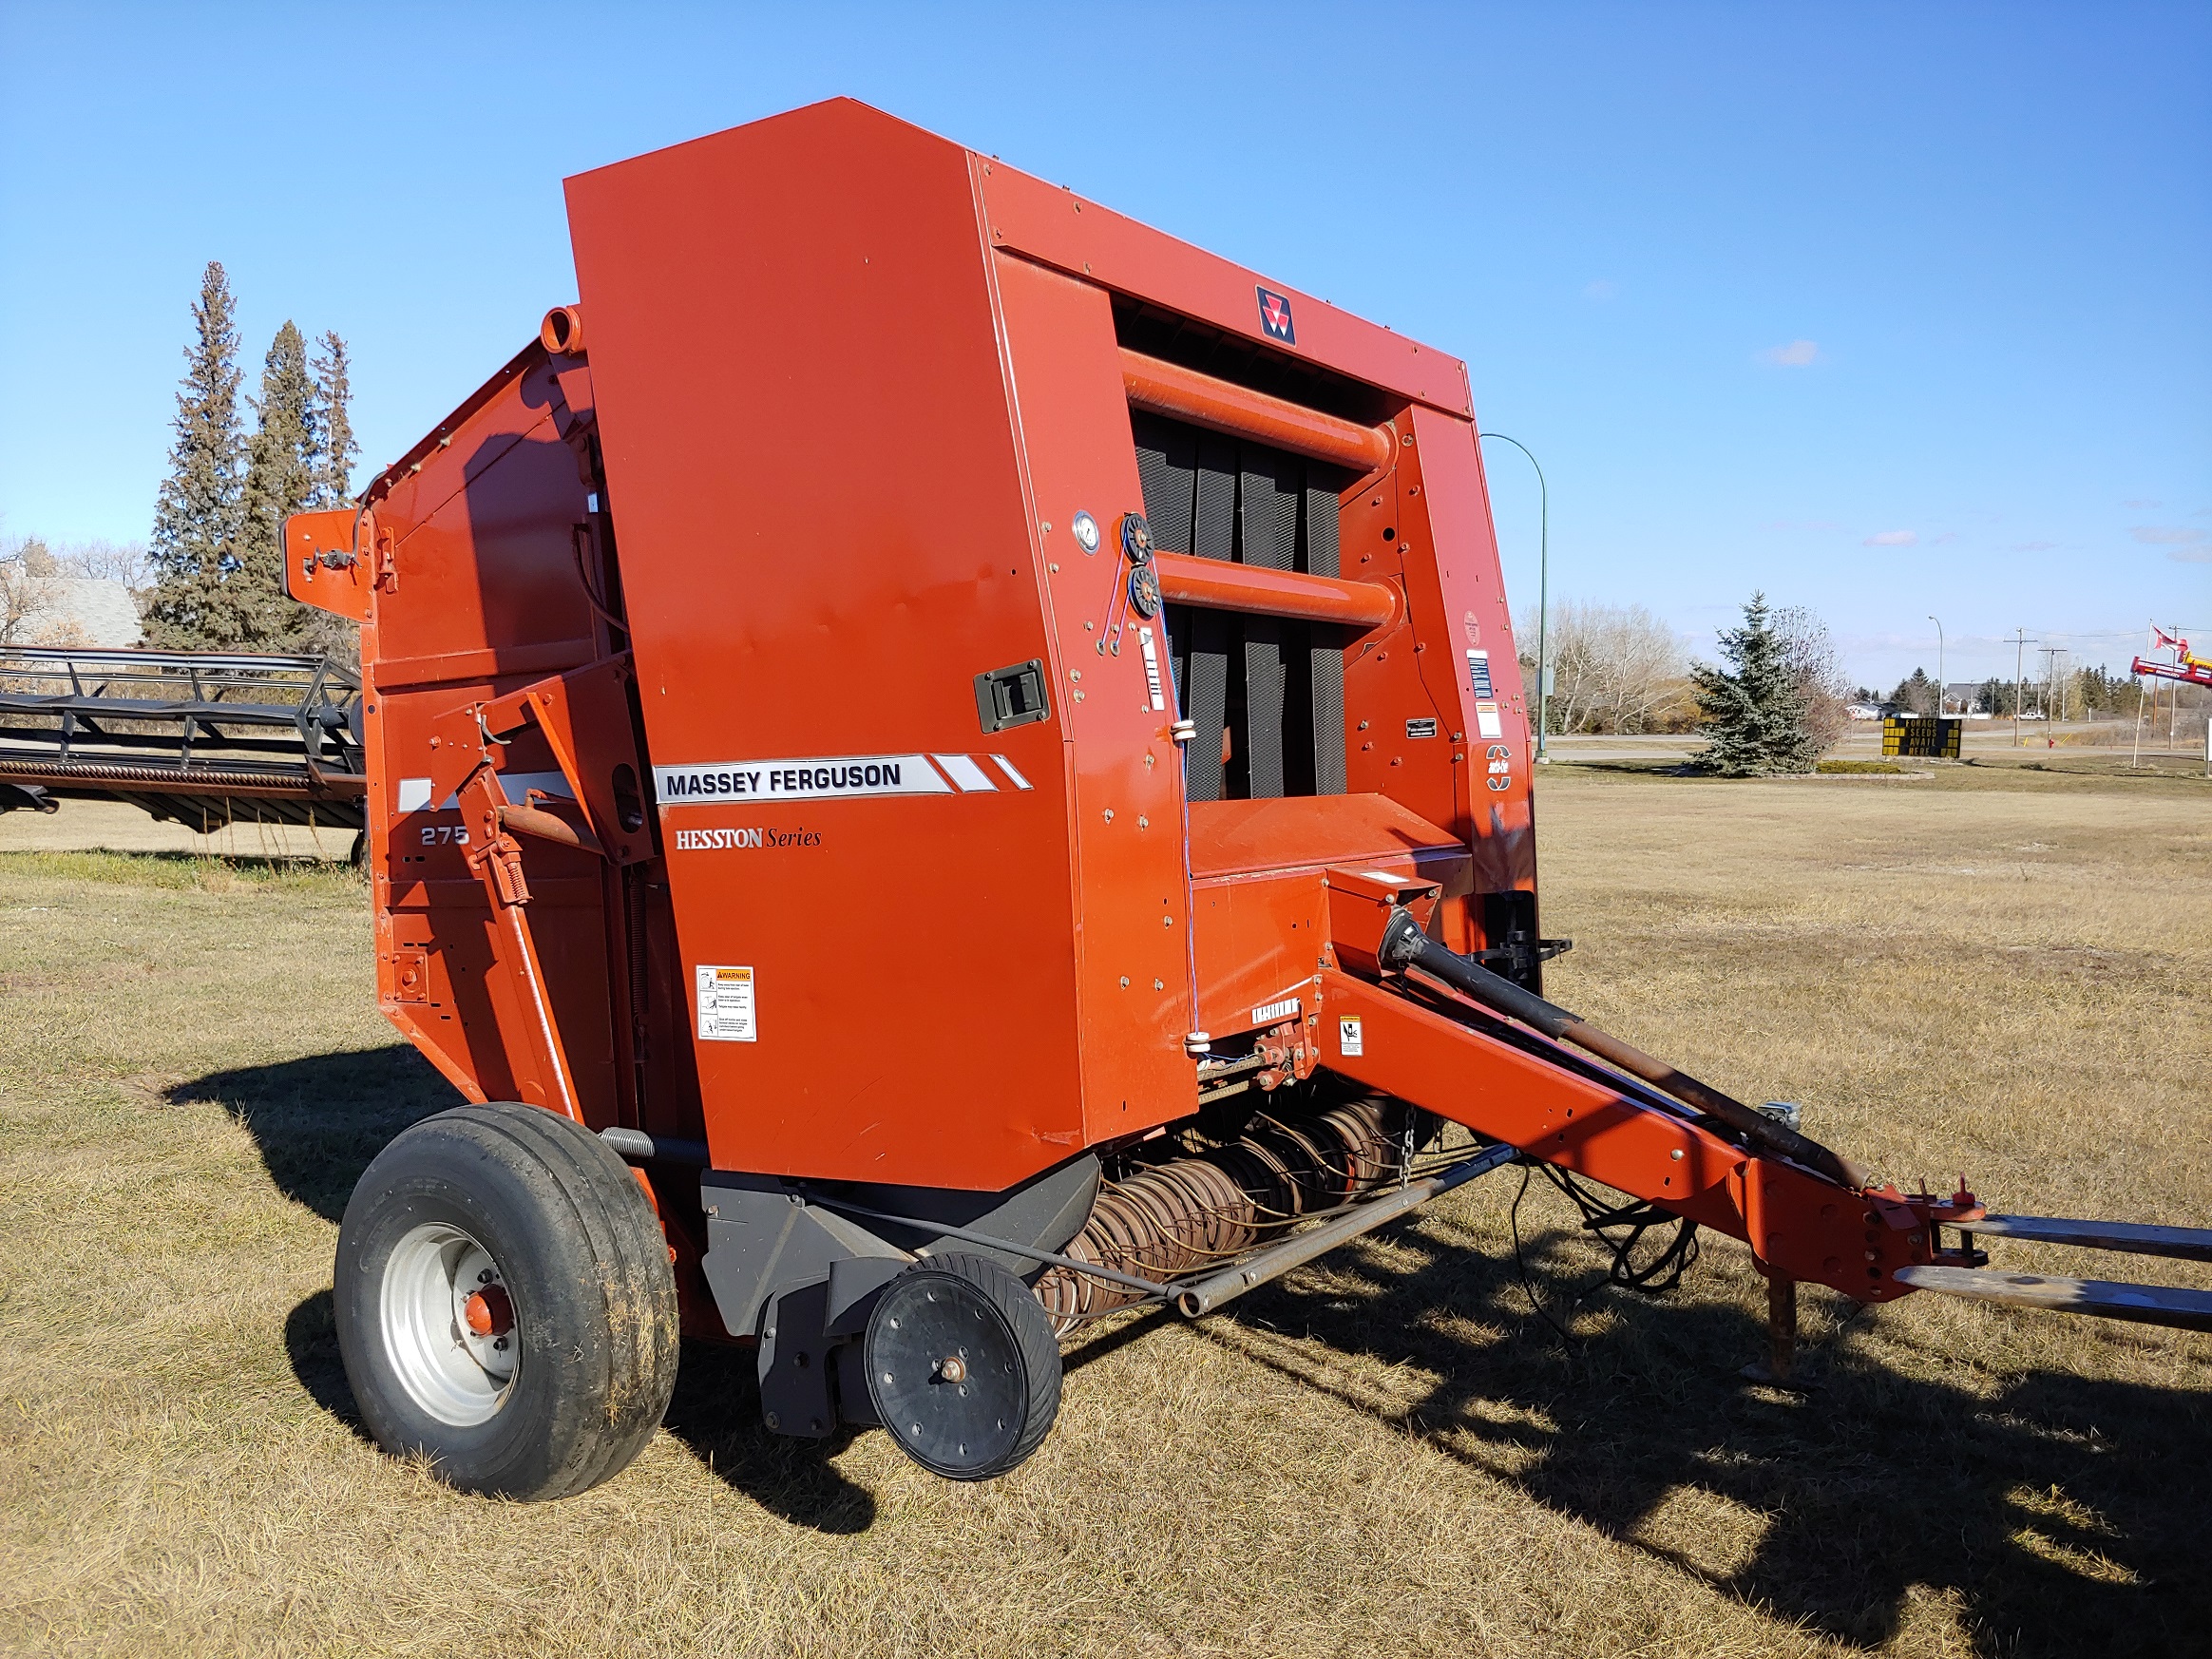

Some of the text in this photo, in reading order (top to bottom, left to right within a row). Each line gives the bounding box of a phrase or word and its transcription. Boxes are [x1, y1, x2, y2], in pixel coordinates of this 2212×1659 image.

[1905, 719, 1937, 728] FORAGE
[1910, 728, 1937, 737] SEEDS
[1909, 737, 1936, 747] AVAIL
[1908, 747, 1930, 756] HERE
[667, 763, 902, 796] MASSEY FERGUSON
[421, 826, 470, 846] 275
[676, 826, 822, 850] HESSTON Series
